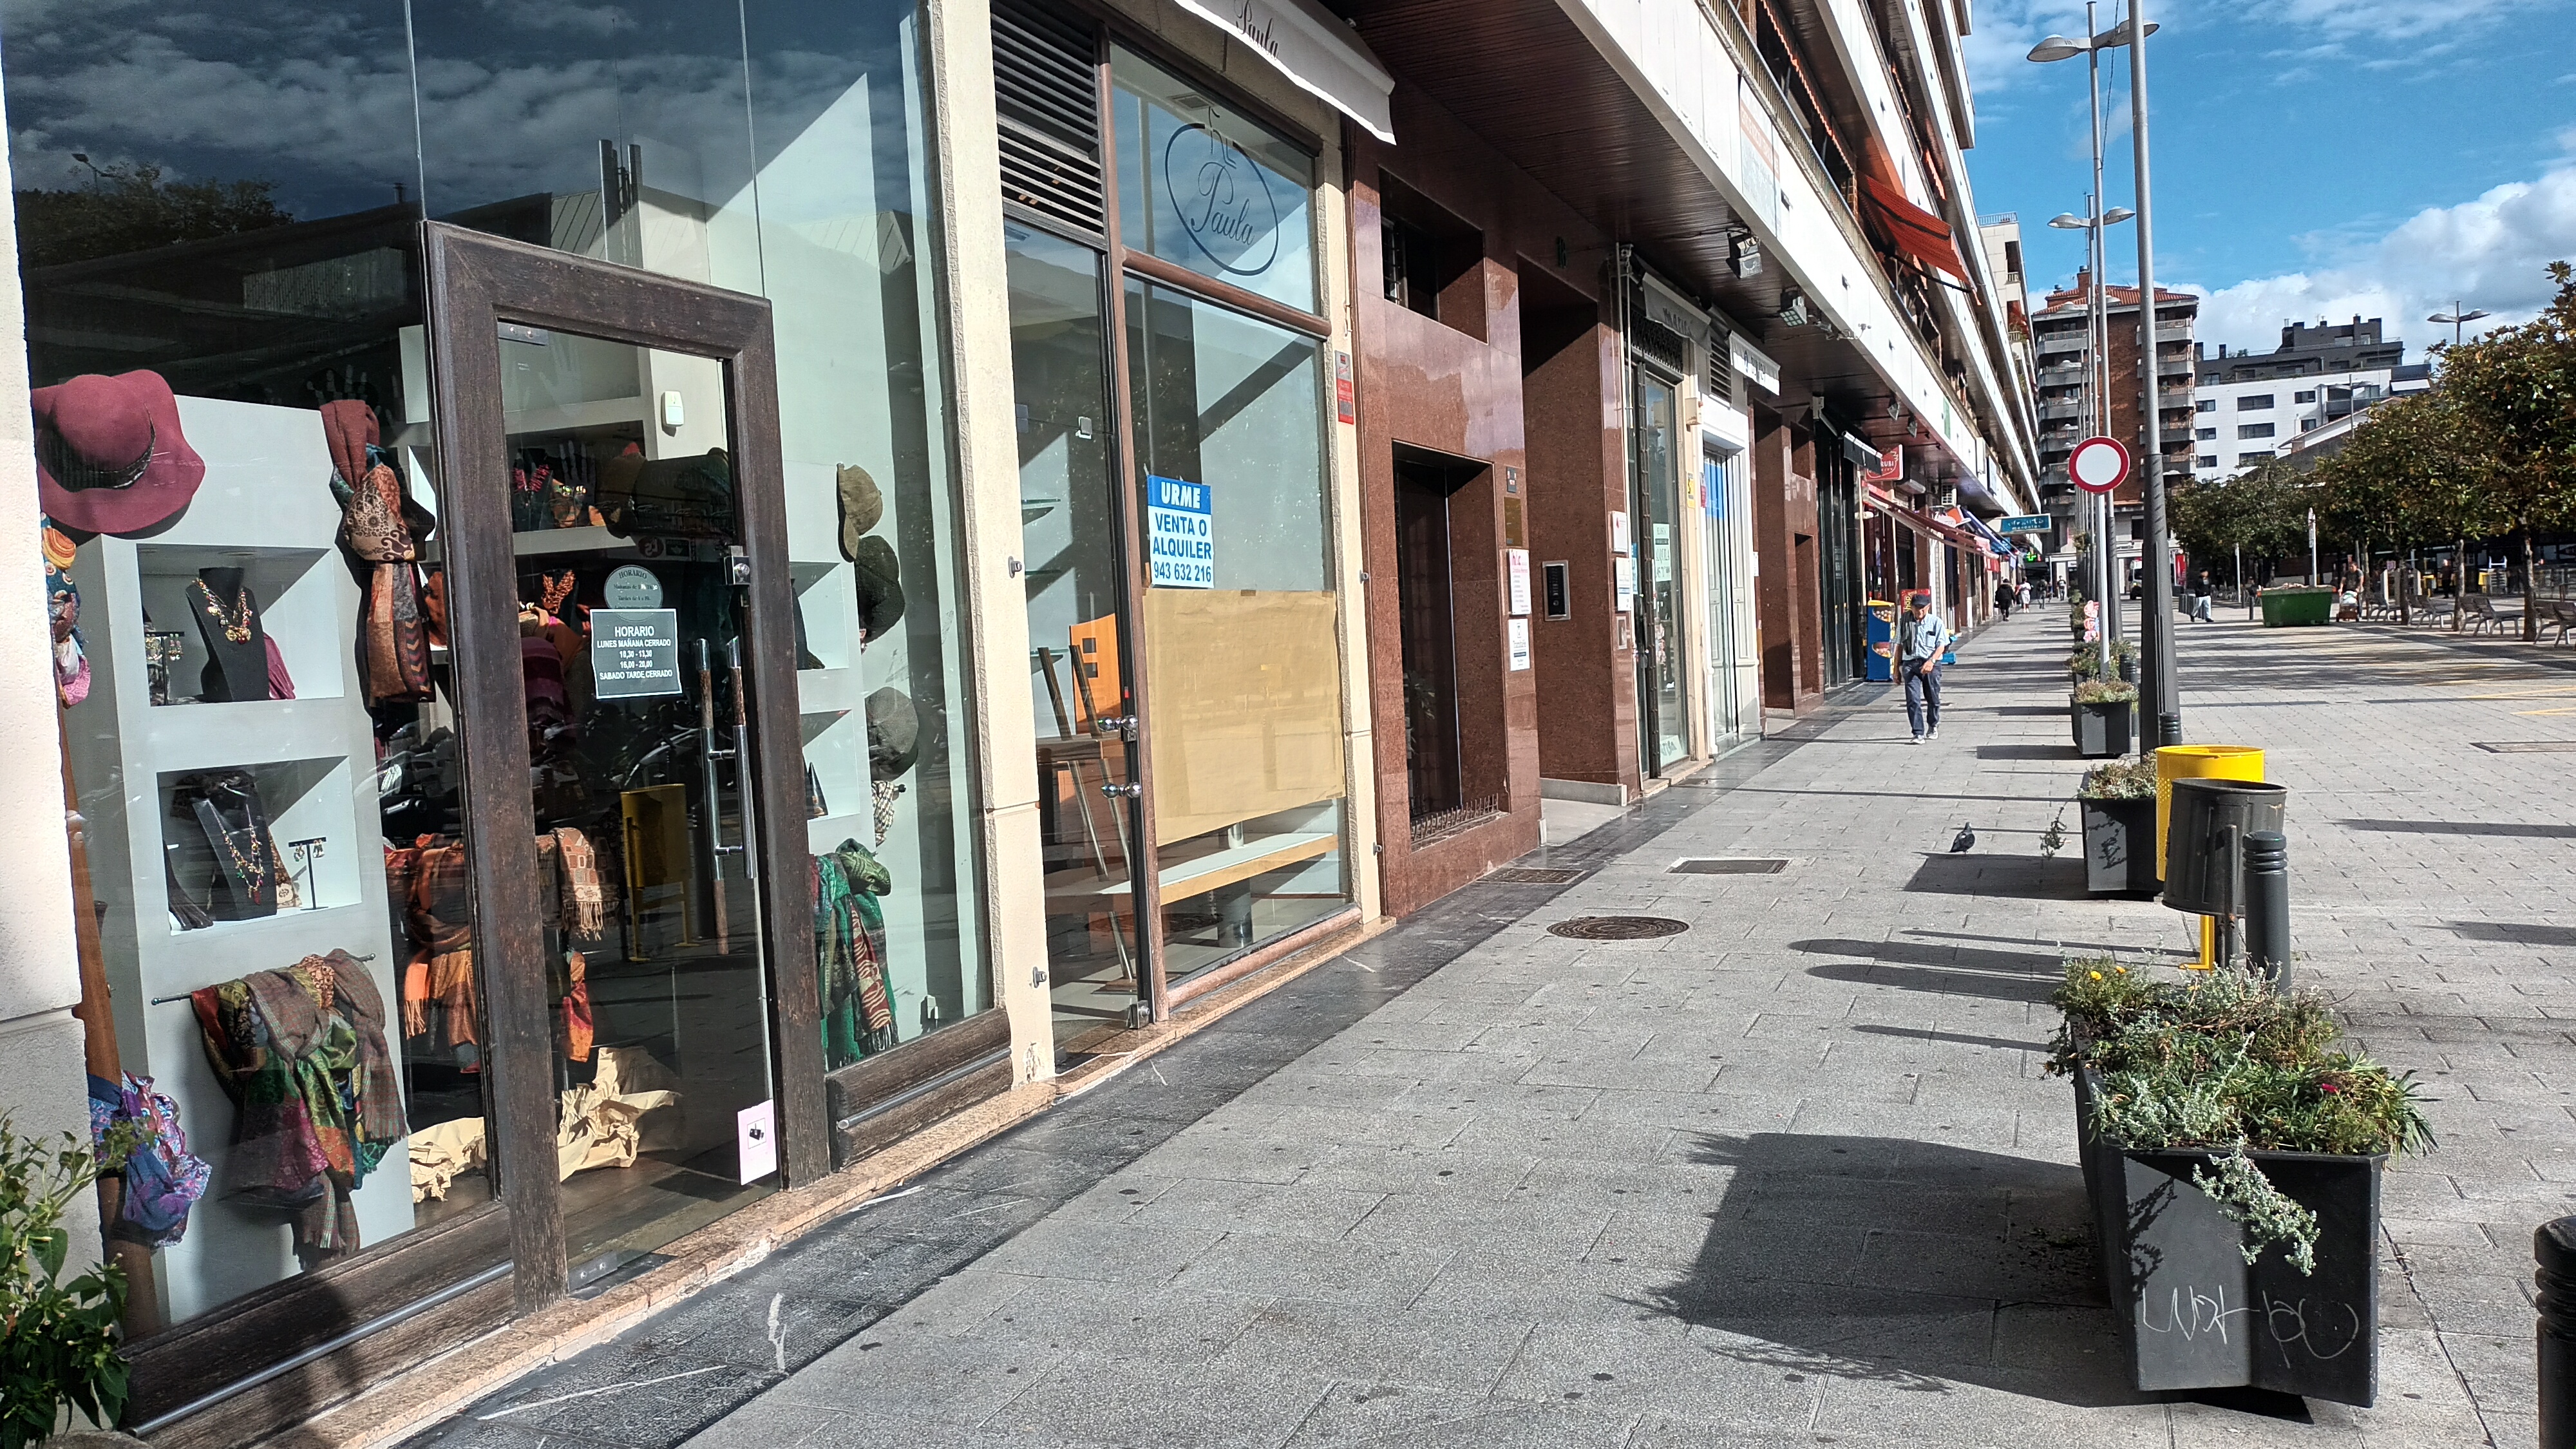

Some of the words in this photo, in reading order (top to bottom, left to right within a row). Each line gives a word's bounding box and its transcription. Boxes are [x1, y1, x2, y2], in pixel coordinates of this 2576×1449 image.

[1233, 0, 1278, 61] Paula
[1191, 162, 1255, 246] Paula
[1161, 481, 1200, 509] URME
[1155, 512, 1195, 535] VENTA
[1199, 519, 1207, 536] O
[1153, 536, 1211, 560] ALQUILER
[618, 569, 647, 579] HORARIO
[1154, 561, 1171, 579] 943
[1174, 563, 1191, 580] 632
[1195, 565, 1211, 582] 216
[614, 625, 655, 637] HORARIO
[618, 638, 644, 647] MAÑANA
[644, 639, 671, 647] CERRADO
[599, 671, 625, 680] SABADO
